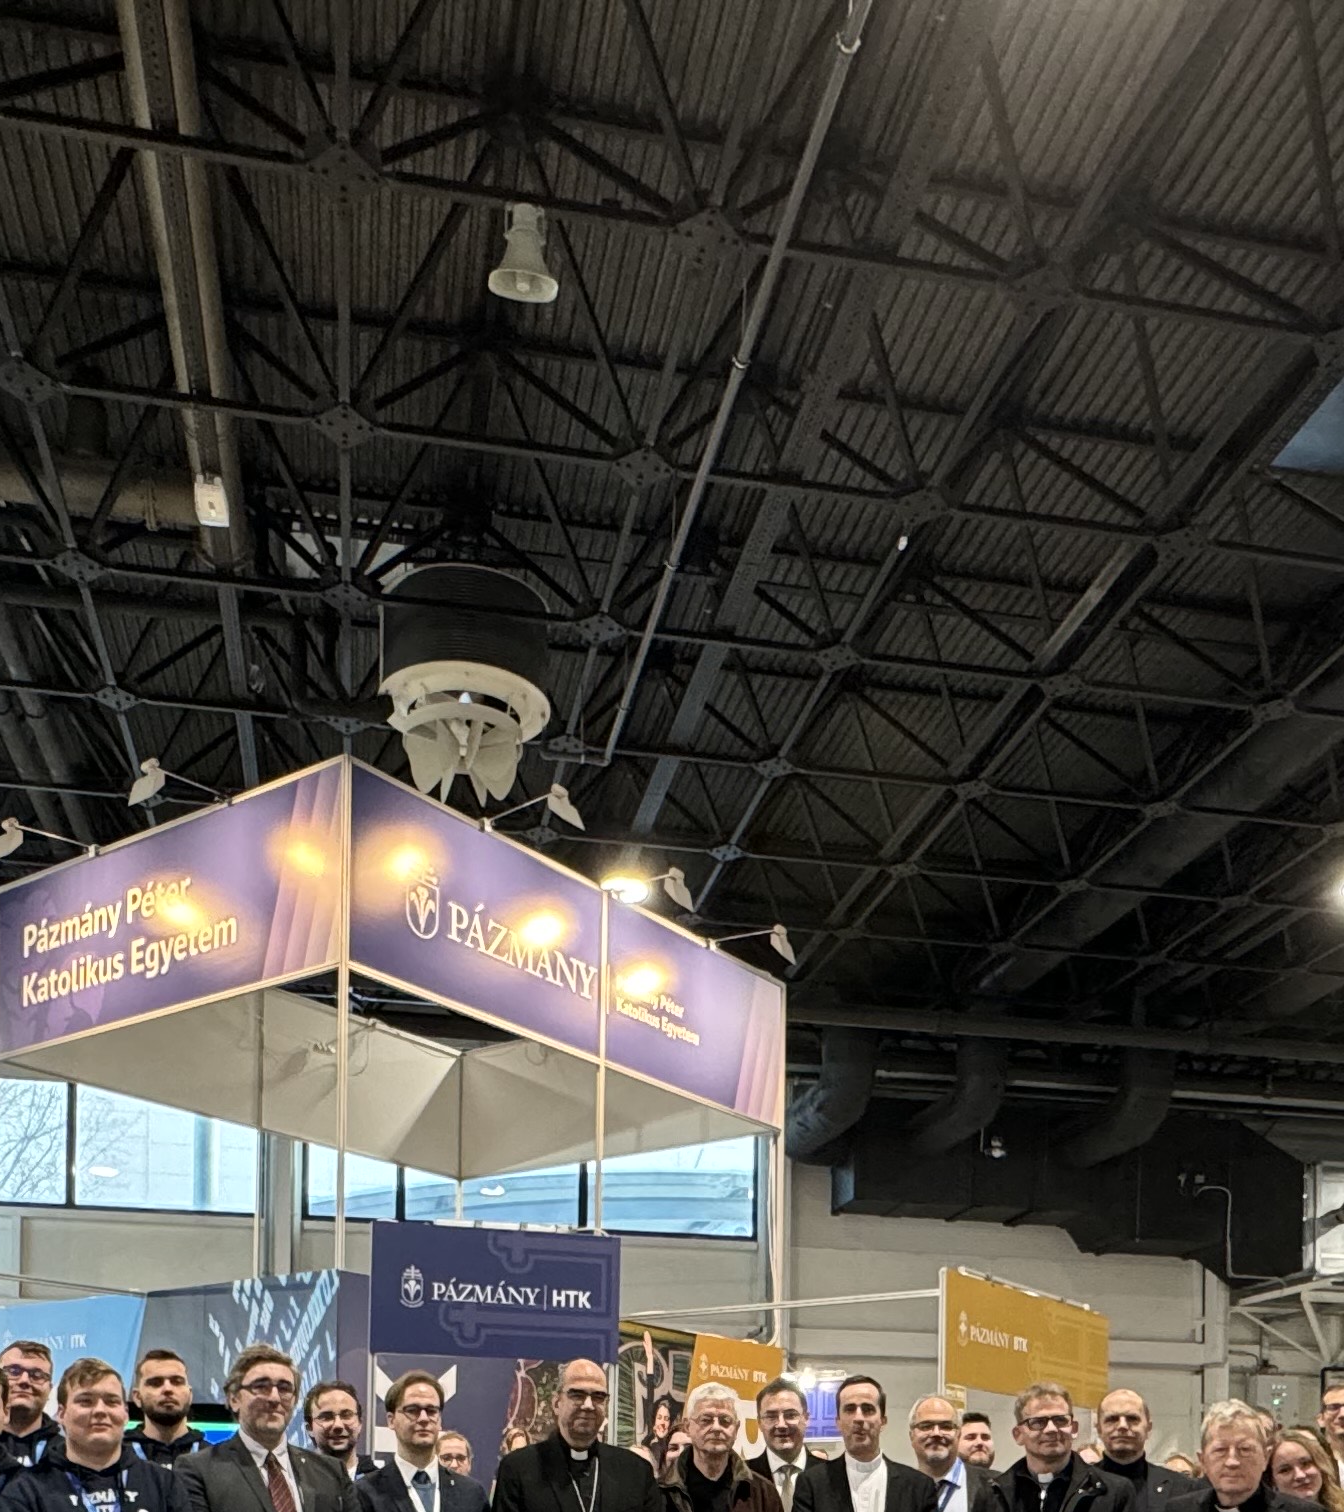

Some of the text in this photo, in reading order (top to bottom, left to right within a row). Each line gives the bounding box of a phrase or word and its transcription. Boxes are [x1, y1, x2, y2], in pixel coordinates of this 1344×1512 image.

[23, 877, 192, 958] Pázmány Péter
[22, 917, 238, 1008] Katolikus Egyetem
[661, 1015, 700, 1047] Egyetem
[431, 1277, 592, 1309] PÁZMÁNY HTK
[970, 1321, 1029, 1353] PÁZMÁNY BTK
[710, 1361, 767, 1383] PÁZMÁNY BTK
